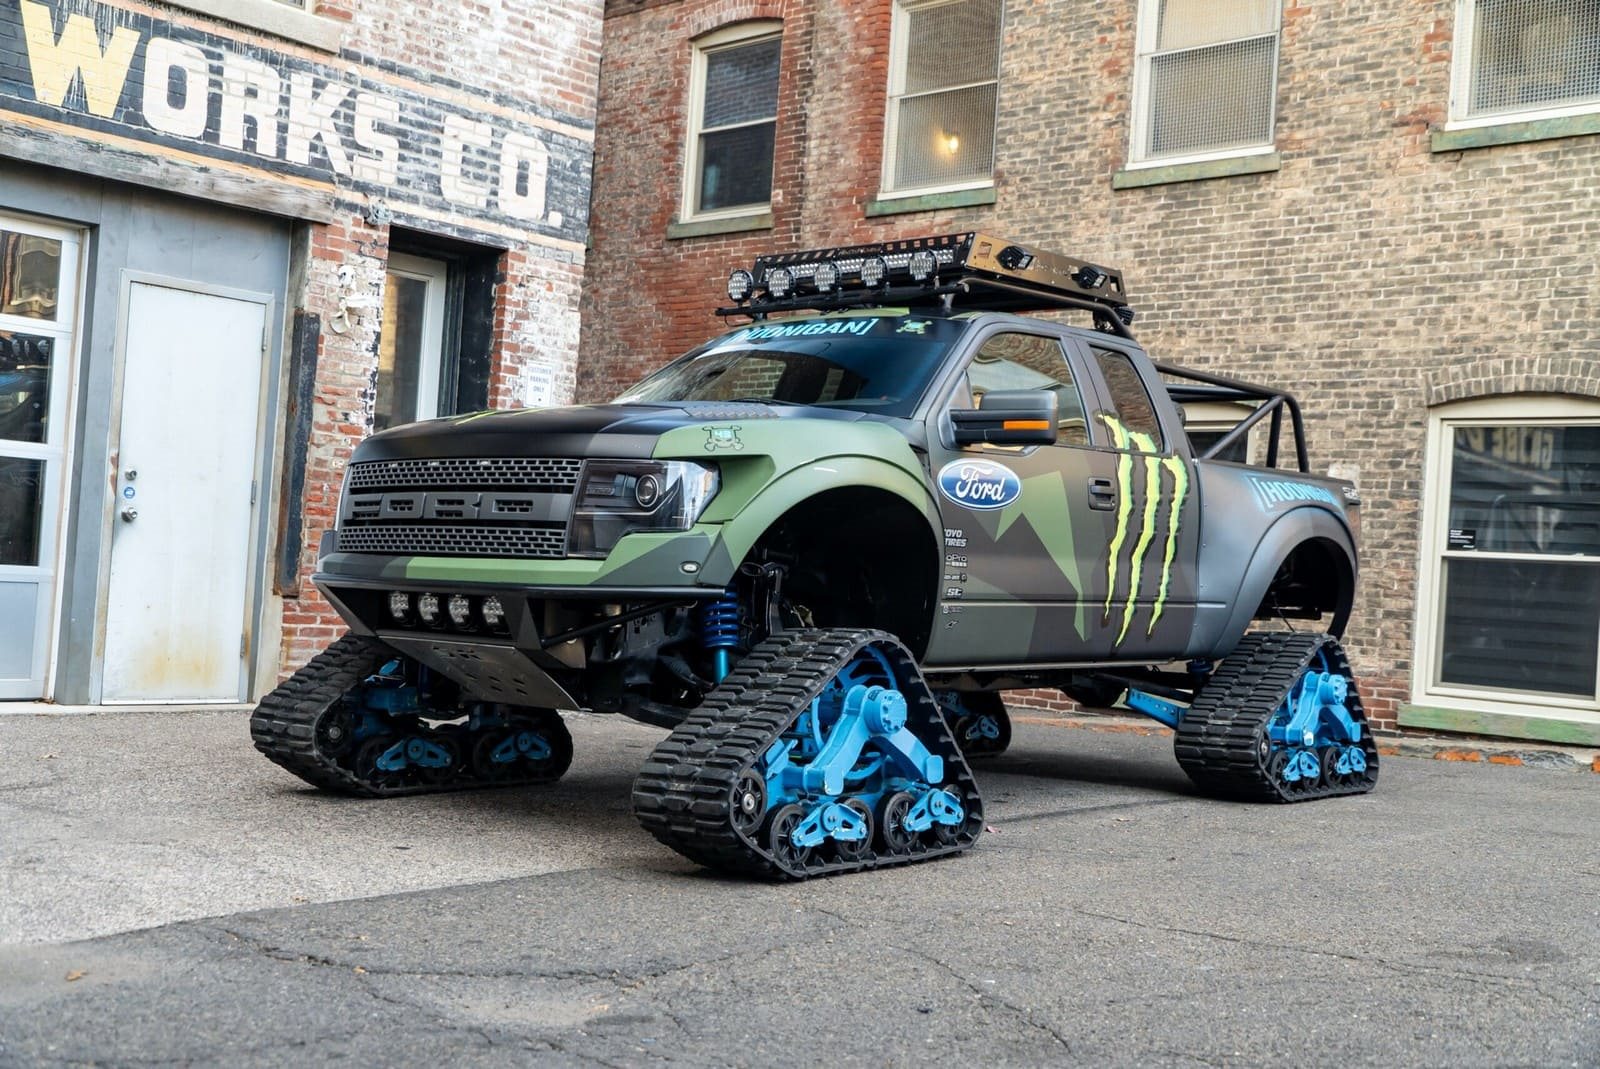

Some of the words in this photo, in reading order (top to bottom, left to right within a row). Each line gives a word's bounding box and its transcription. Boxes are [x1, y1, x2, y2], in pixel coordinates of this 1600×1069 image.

[20, 0, 399, 184] WORKS
[440, 115, 562, 227] CO.
[956, 465, 1006, 501] Ford
[945, 538, 967, 546] TIRES
[946, 554, 967, 562] oPro
